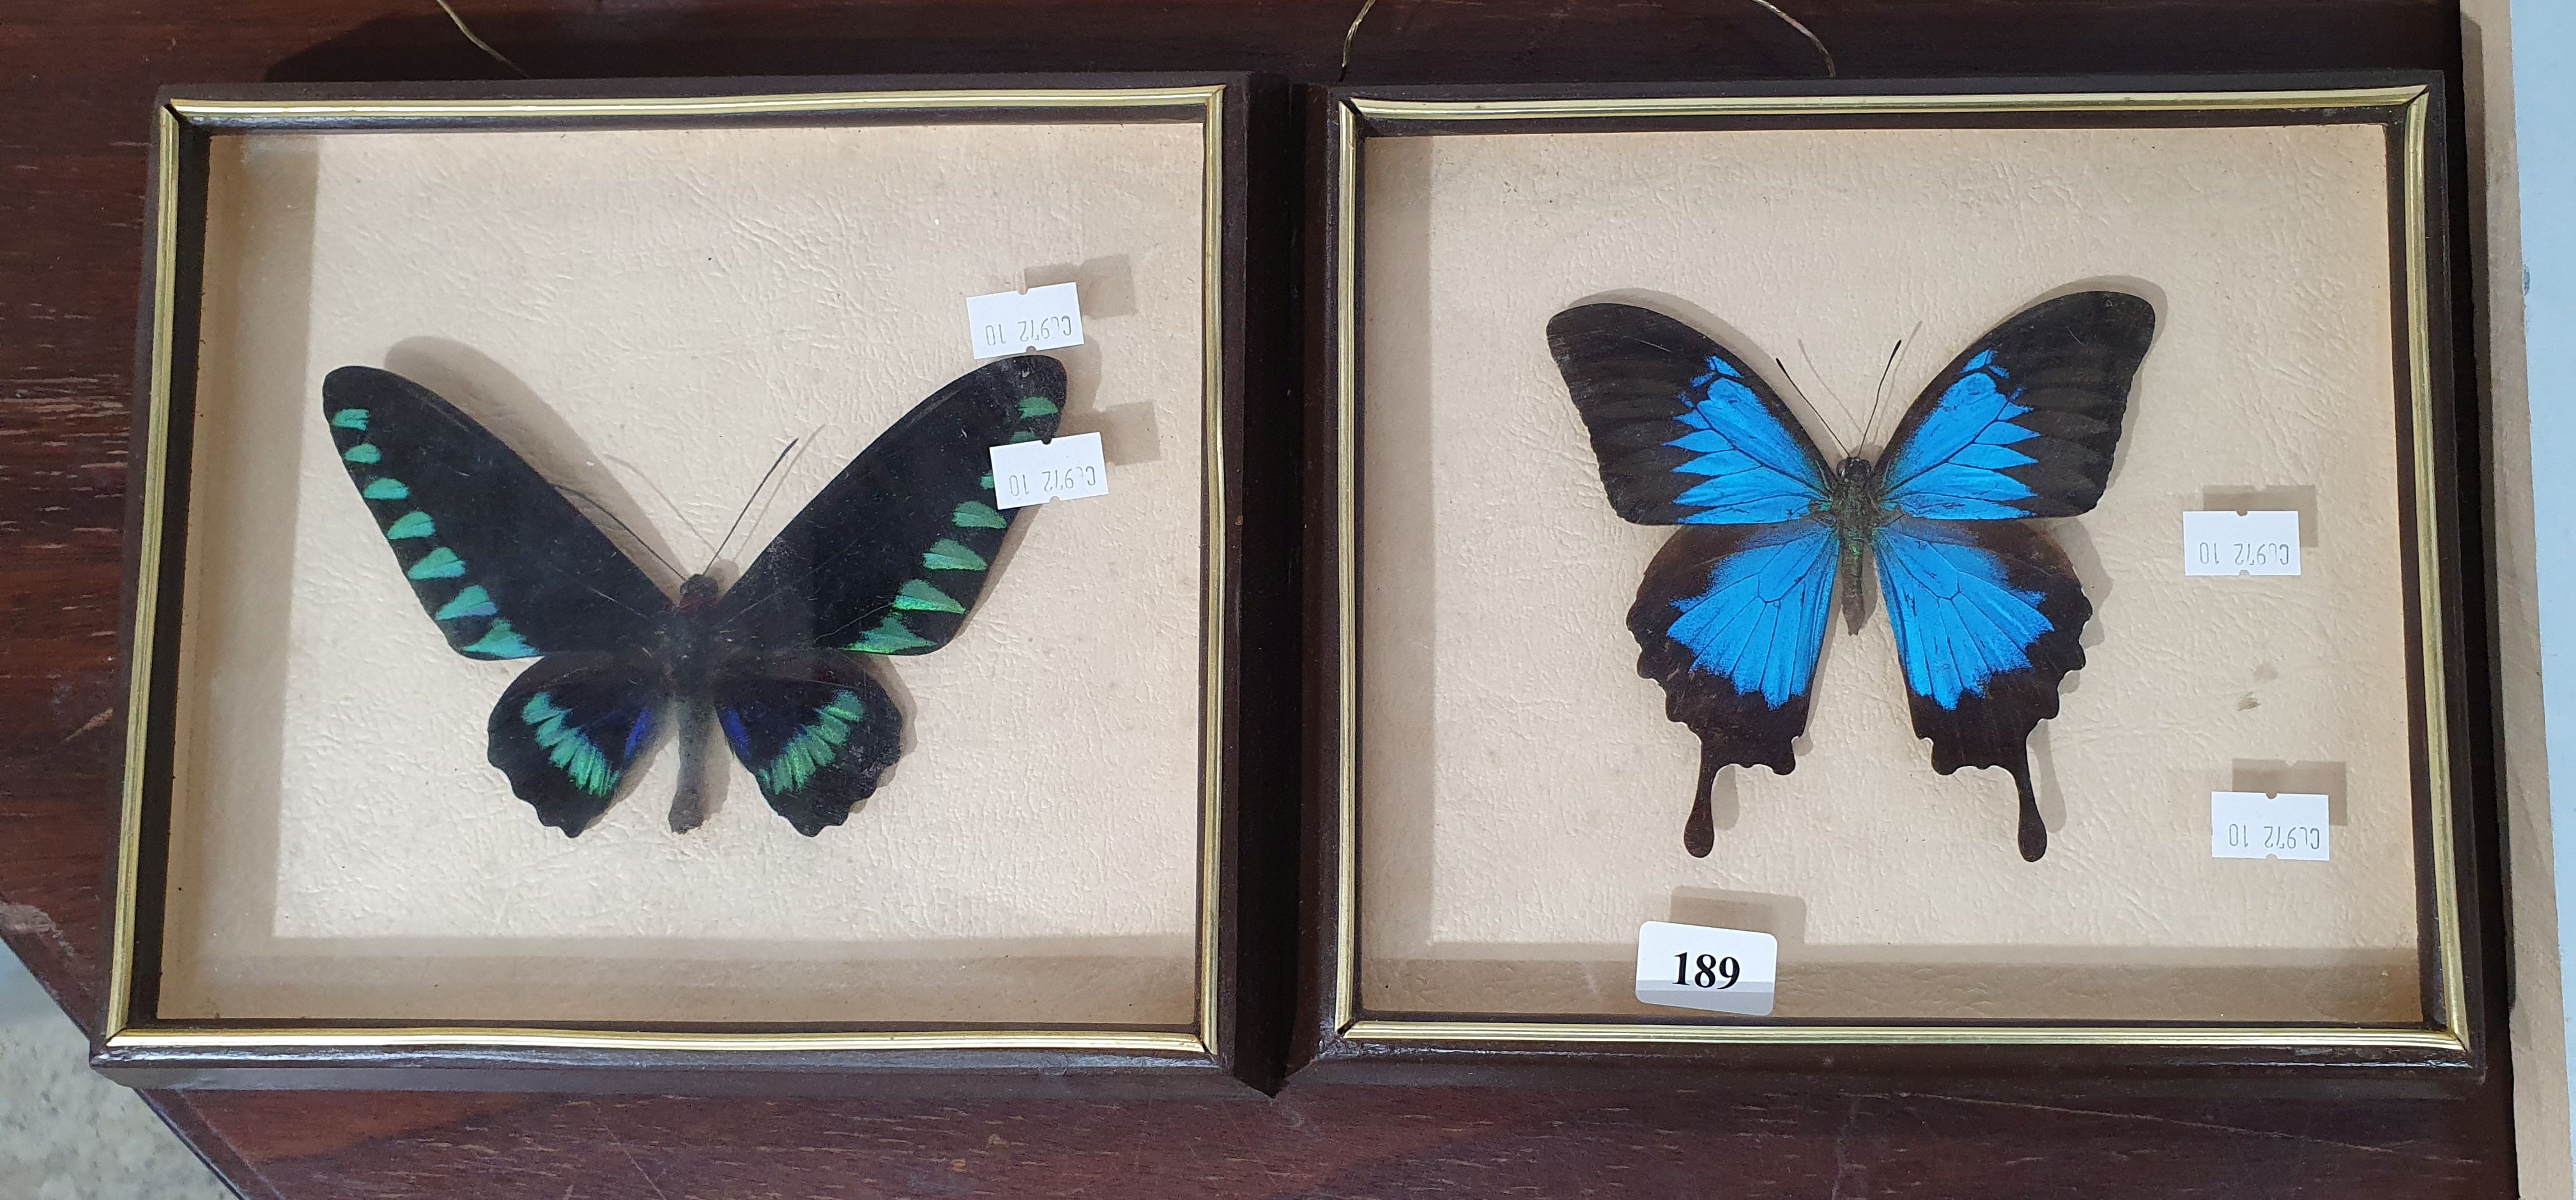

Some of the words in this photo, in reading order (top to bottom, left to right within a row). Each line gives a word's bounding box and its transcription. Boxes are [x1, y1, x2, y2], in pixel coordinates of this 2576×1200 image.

[985, 323, 1006, 346] 10
[1009, 474, 1030, 496] 10
[2199, 542, 2220, 564] 10
[2228, 823, 2249, 848] 10
[1672, 951, 1740, 990] 189
